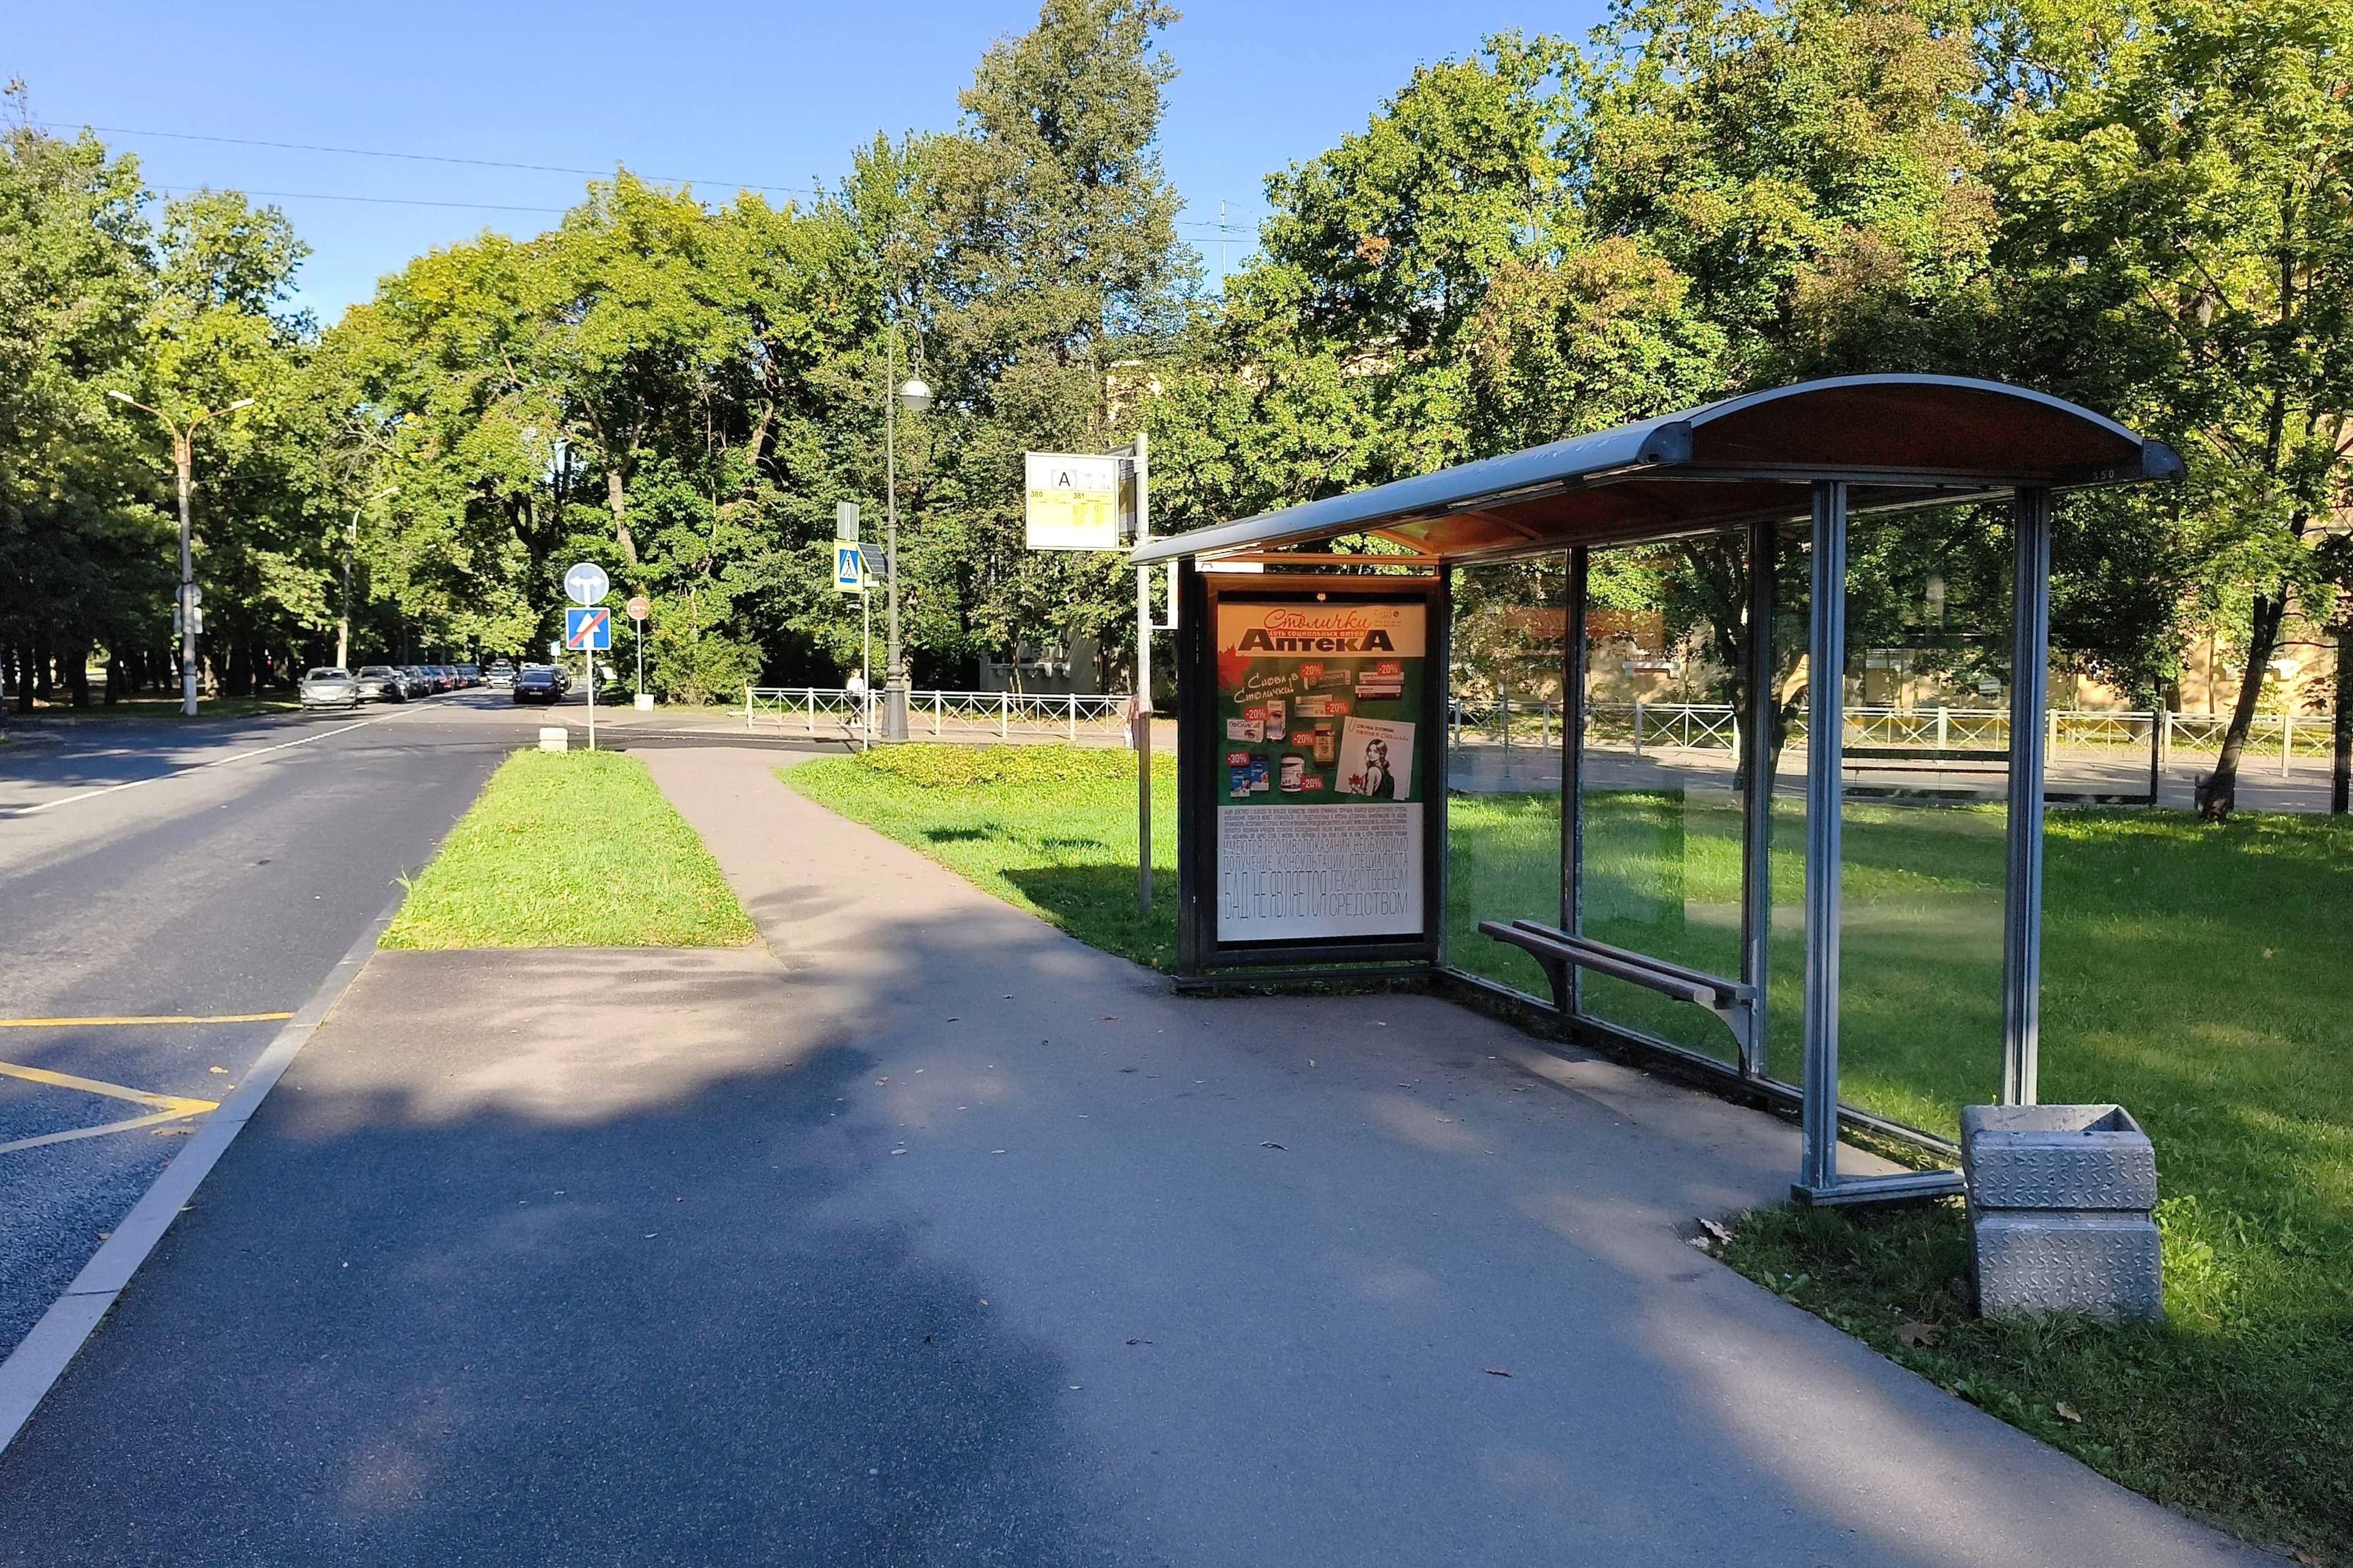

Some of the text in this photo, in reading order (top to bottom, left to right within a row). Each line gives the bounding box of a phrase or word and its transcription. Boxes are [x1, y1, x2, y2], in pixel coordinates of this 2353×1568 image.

[1264, 608, 1373, 630] Столички
[1302, 665, 1321, 675] -20%
[1379, 664, 1398, 674] -20%
[1327, 702, 1347, 713] -20%
[1246, 709, 1266, 719] -20%
[1294, 733, 1313, 744] -20%
[1228, 754, 1246, 763] -30%
[1302, 779, 1322, 789] -20%
[1354, 837, 1408, 853] НЕОБХОДИМО
[1224, 853, 1408, 871] ПОЛУЧЕНИЕ КОНСУЛЬТАЦИИ СПЕЦИАЛИСТА
[1330, 869, 1408, 892] ЛЕКАРСТВЕННЫМ
[1225, 871, 1327, 920] БАД НЕ ЯВЛЯЕТСЯ
[1329, 892, 1408, 918] СРЕДСТВОМ
